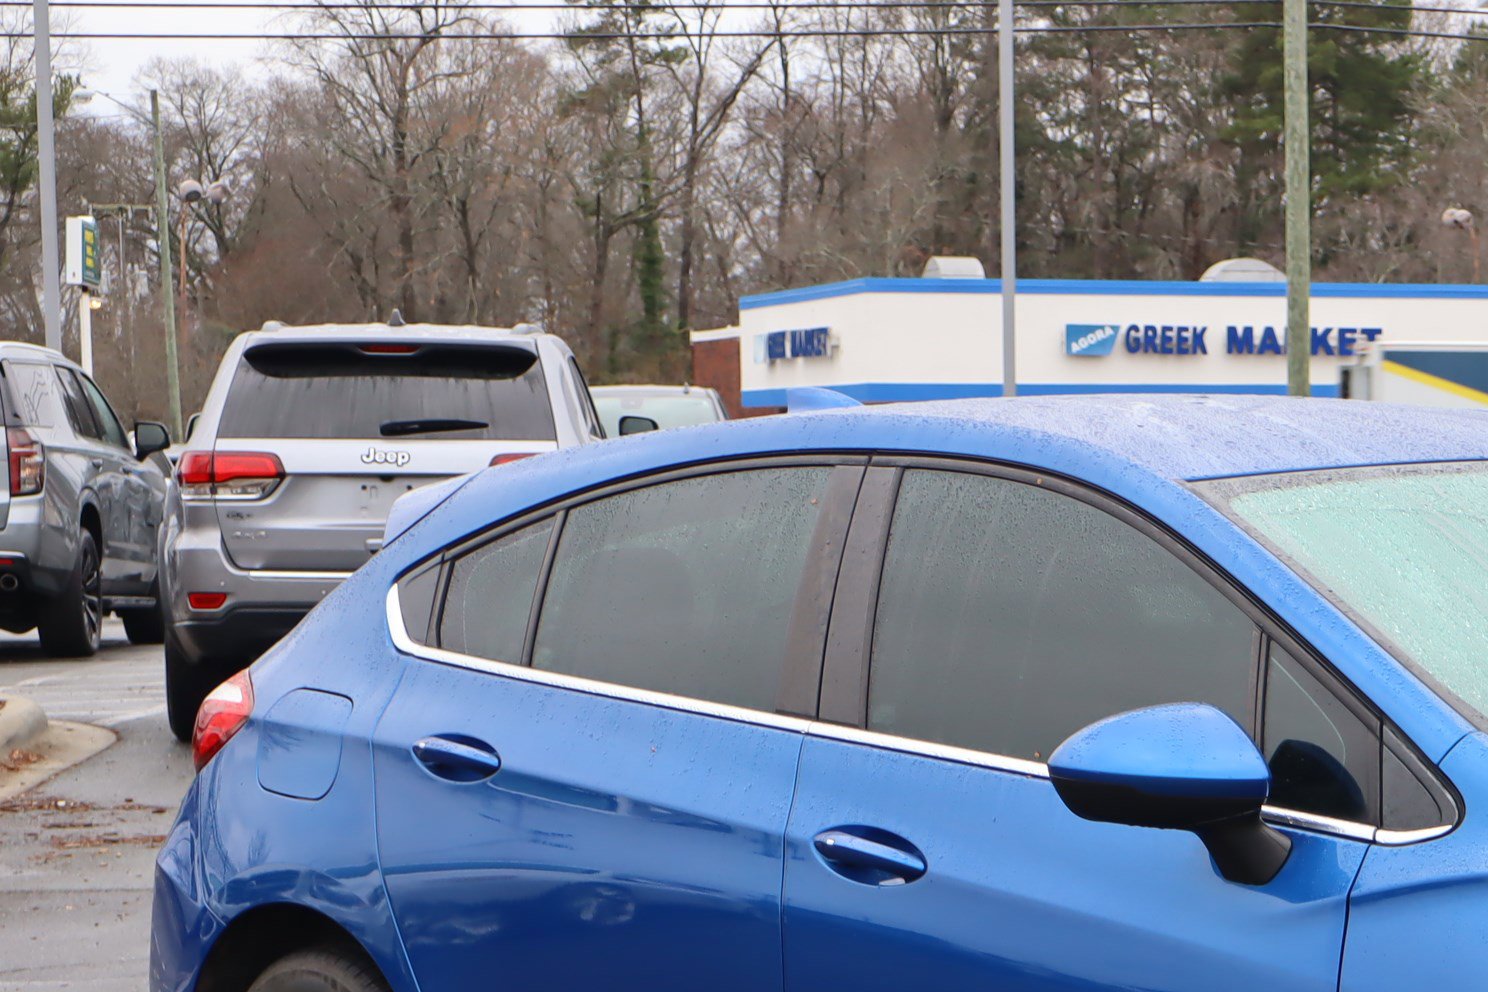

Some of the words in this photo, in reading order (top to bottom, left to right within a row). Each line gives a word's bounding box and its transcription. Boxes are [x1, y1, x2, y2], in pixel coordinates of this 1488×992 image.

[1070, 325, 1115, 353] AGORA
[1125, 324, 1208, 355] GREEK
[1226, 325, 1383, 357] MAKET
[361, 447, 410, 466] Jeep
